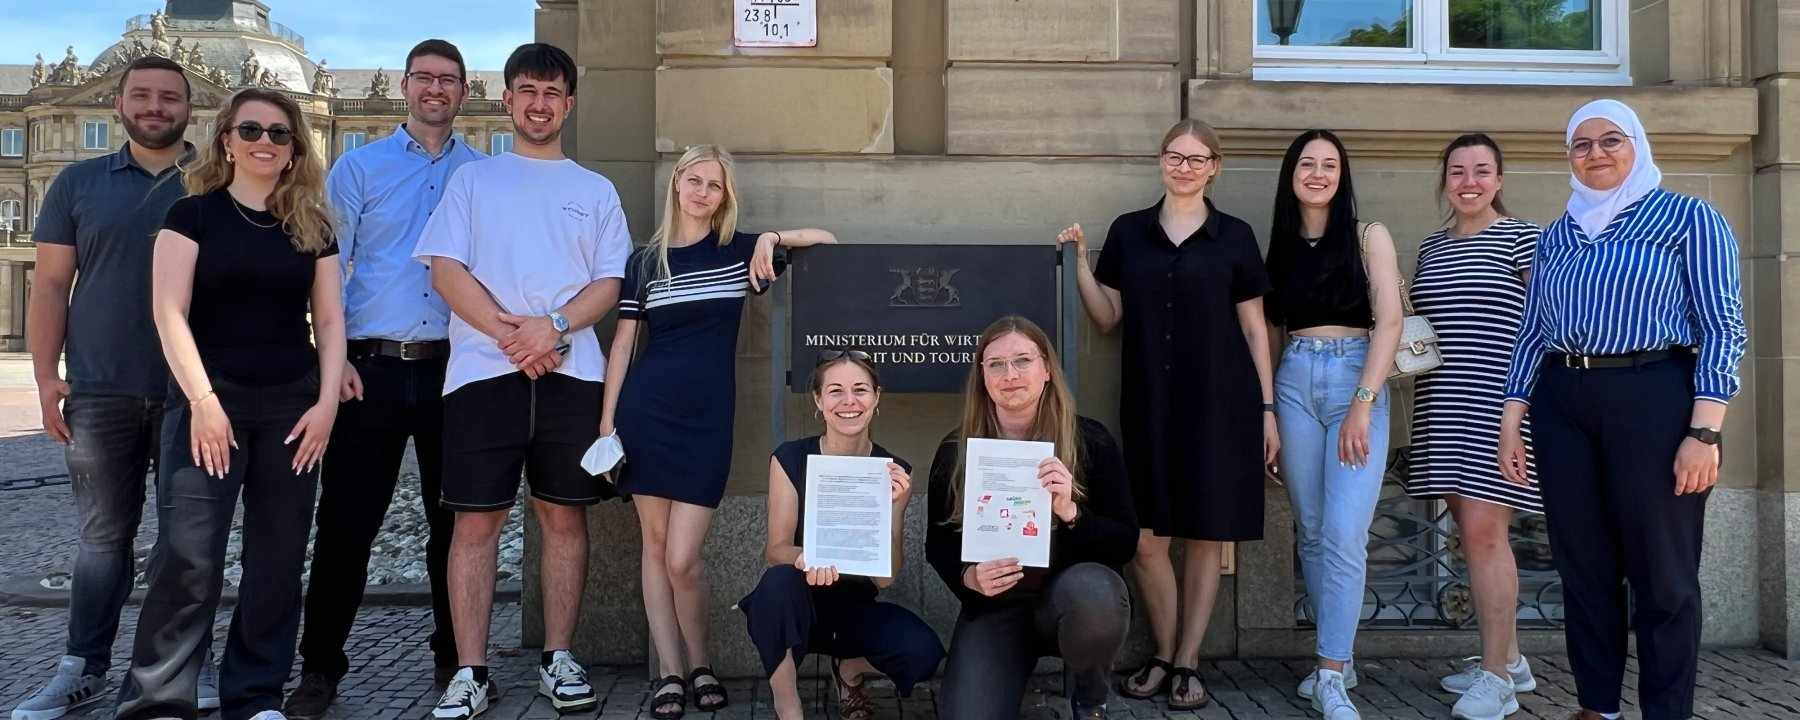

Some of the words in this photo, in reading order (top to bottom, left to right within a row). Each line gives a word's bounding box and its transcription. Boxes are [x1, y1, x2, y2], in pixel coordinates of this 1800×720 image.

[763, 23, 789, 39] 10,1
[805, 334, 906, 346] MINISTERIUM
[911, 332, 940, 346] FÜR
[944, 334, 983, 346] WIRT
[873, 352, 888, 363] IT
[891, 352, 927, 363] UND
[929, 352, 977, 363] TOURI
